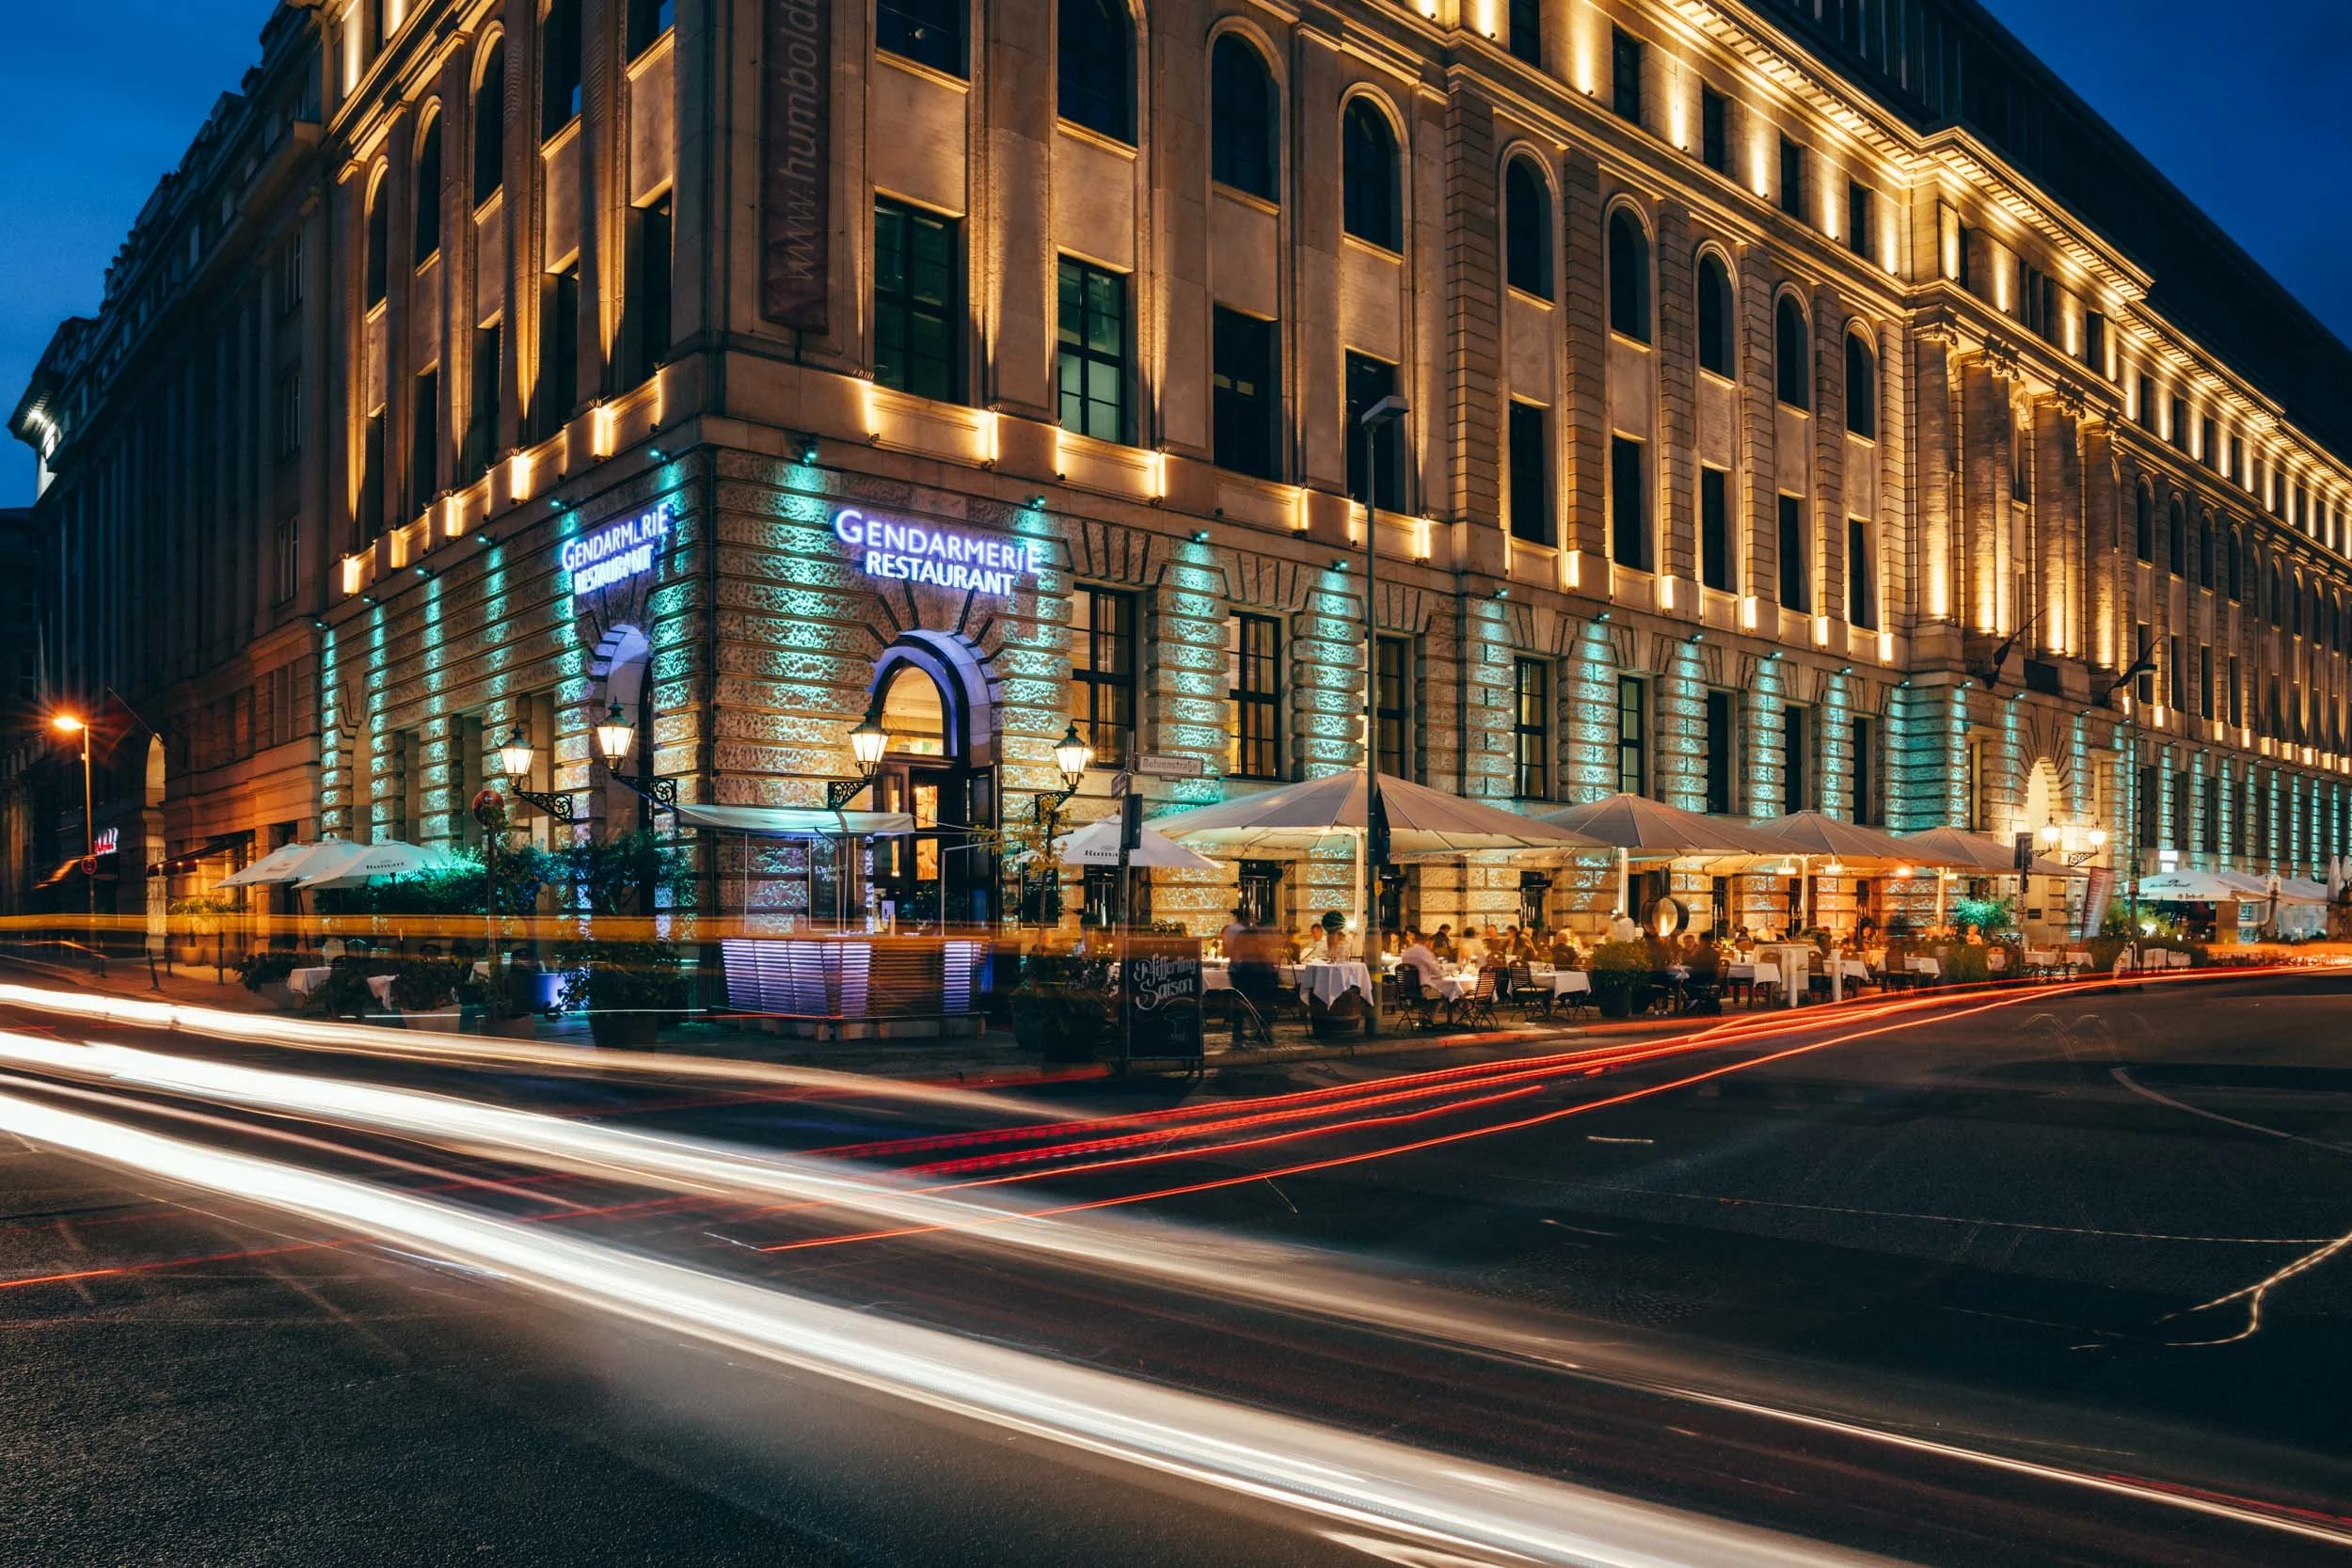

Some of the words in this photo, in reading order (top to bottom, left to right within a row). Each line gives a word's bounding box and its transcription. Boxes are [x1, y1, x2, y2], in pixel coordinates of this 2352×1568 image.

[835, 509, 1042, 574] GENDARMERIE
[574, 544, 654, 595] RESTAURANT
[866, 551, 1015, 595] RESTAURANT
[1136, 978, 1194, 1010] Saison
